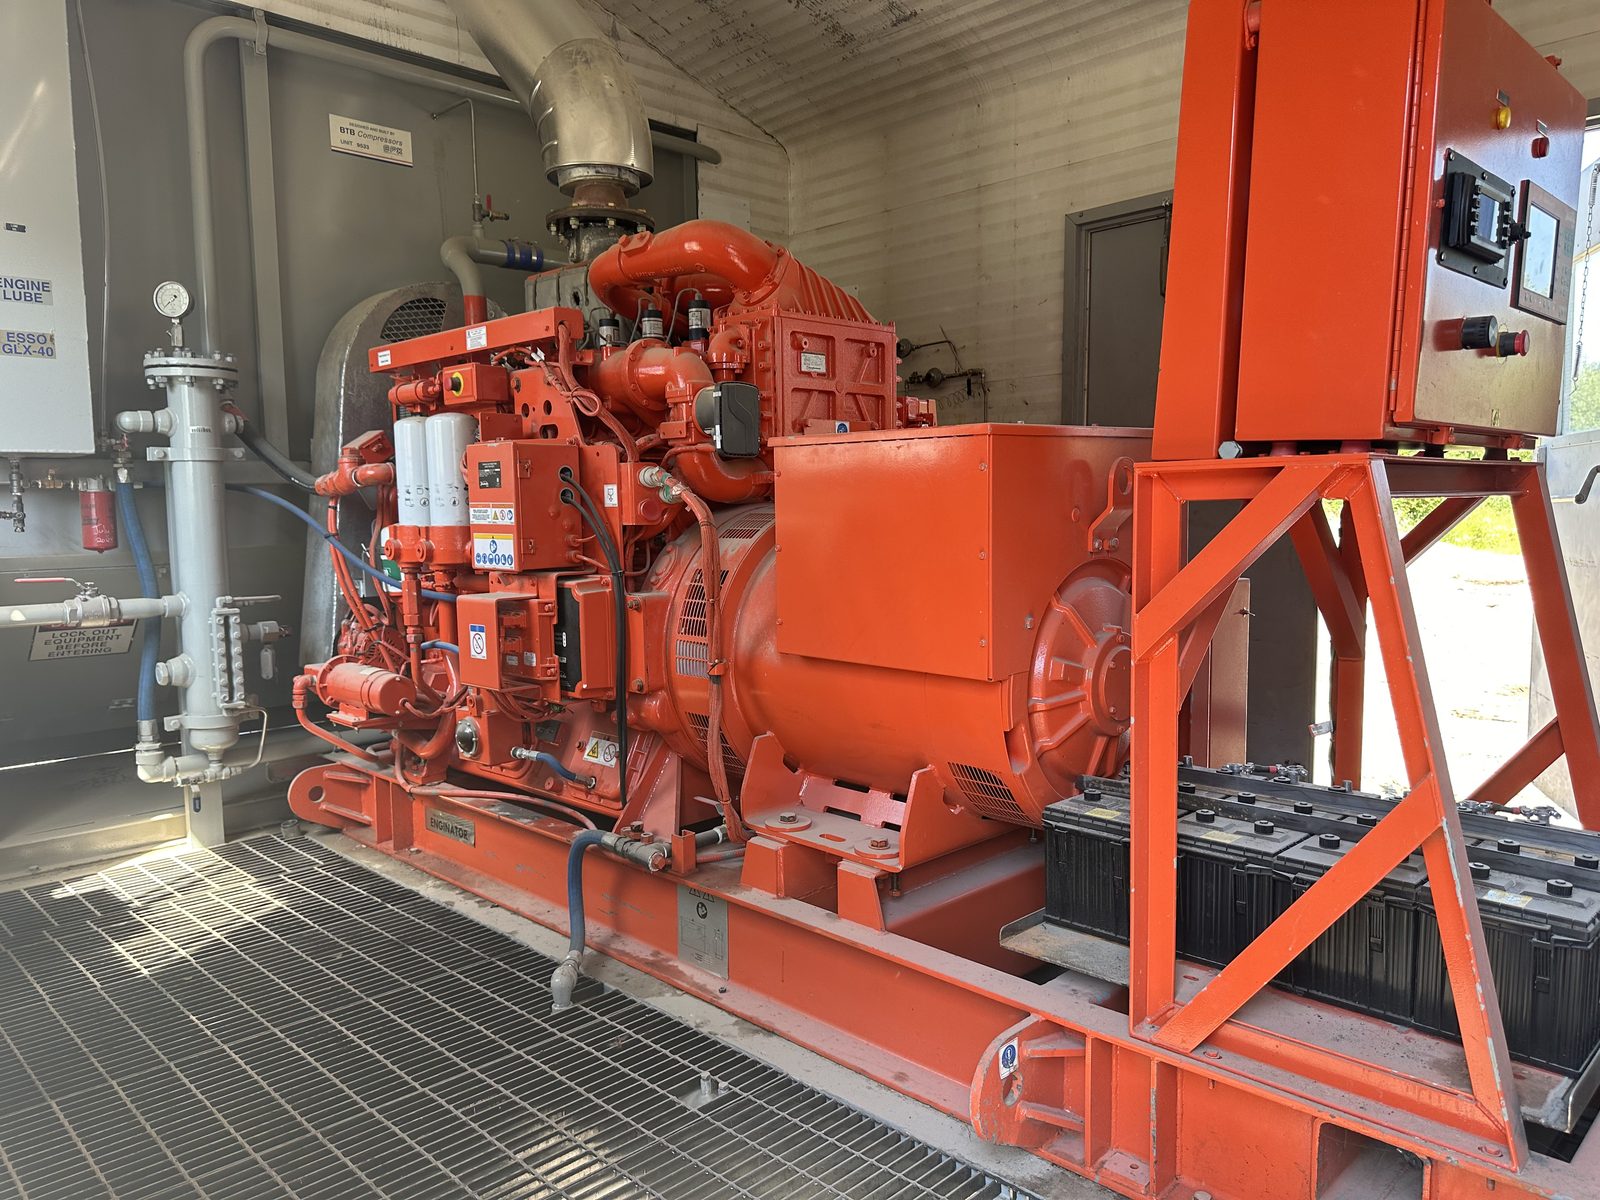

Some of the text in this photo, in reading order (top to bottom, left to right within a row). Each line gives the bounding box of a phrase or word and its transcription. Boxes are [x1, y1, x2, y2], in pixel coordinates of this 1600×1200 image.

[339, 126, 403, 147] BTB Compressors
[3, 289, 43, 303] LUBE
[6, 332, 47, 345] ESSO
[2, 343, 54, 357] GLX-40
[44, 634, 122, 646] EQUIPMENT
[51, 630, 87, 639] LOCK
[47, 647, 112, 657] ENTERING
[55, 641, 108, 651] BEFORE
[430, 817, 469, 840] ENGINATOR
